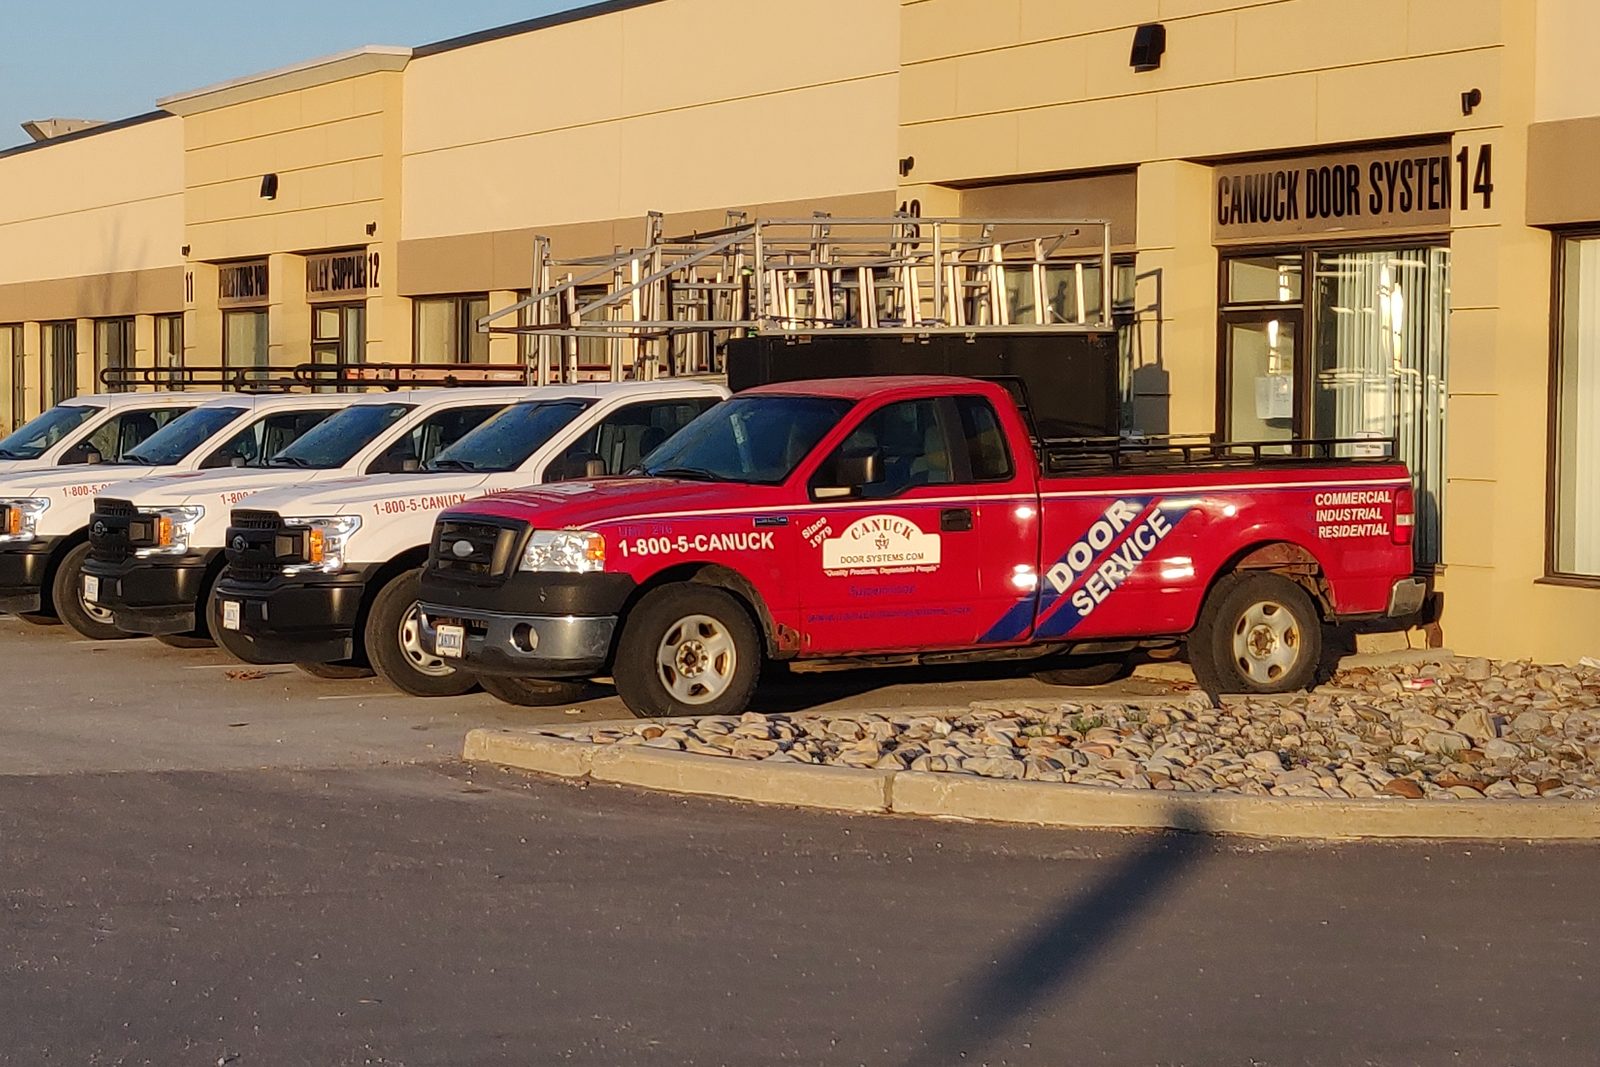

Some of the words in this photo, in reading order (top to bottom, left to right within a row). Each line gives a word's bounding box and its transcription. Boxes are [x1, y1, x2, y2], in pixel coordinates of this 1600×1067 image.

[1456, 143, 1494, 211] 14
[1217, 170, 1300, 226] CANUCK
[1305, 164, 1361, 219] DOOR
[368, 252, 380, 289] 12
[185, 271, 194, 303] 11
[372, 493, 466, 515] 1-800-5-CANUCK
[1315, 491, 1392, 506] COMMERCIAL
[1316, 507, 1383, 522] INDUSTRIAL
[801, 516, 827, 540] Since
[809, 525, 833, 549] 1979
[851, 519, 914, 541] CANUCK
[1318, 523, 1390, 539] RESIDENTIAL
[618, 532, 775, 558] 1-800-5-CANUCK
[1046, 499, 1138, 594] DOOR
[840, 555, 865, 564] DOOR
[866, 552, 925, 563] SYSTEMS.COM
[1071, 508, 1173, 617] SERVICE
